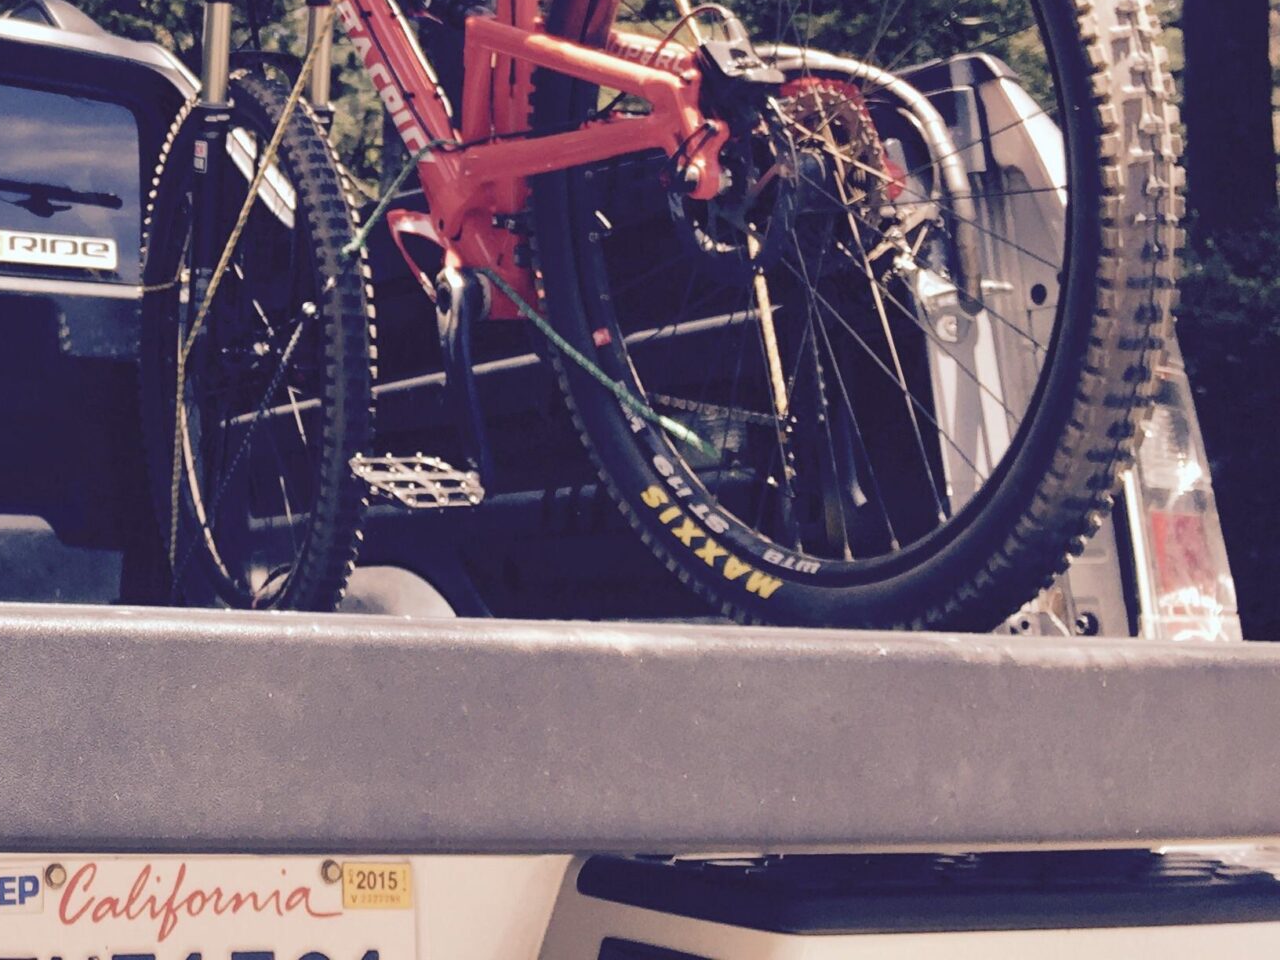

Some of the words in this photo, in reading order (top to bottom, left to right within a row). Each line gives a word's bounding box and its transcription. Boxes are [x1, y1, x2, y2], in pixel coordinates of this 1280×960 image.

[640, 484, 783, 600] MAXXIS
[762, 547, 822, 575] WTB
[57, 861, 343, 943] California
[356, 870, 399, 891] 2015
